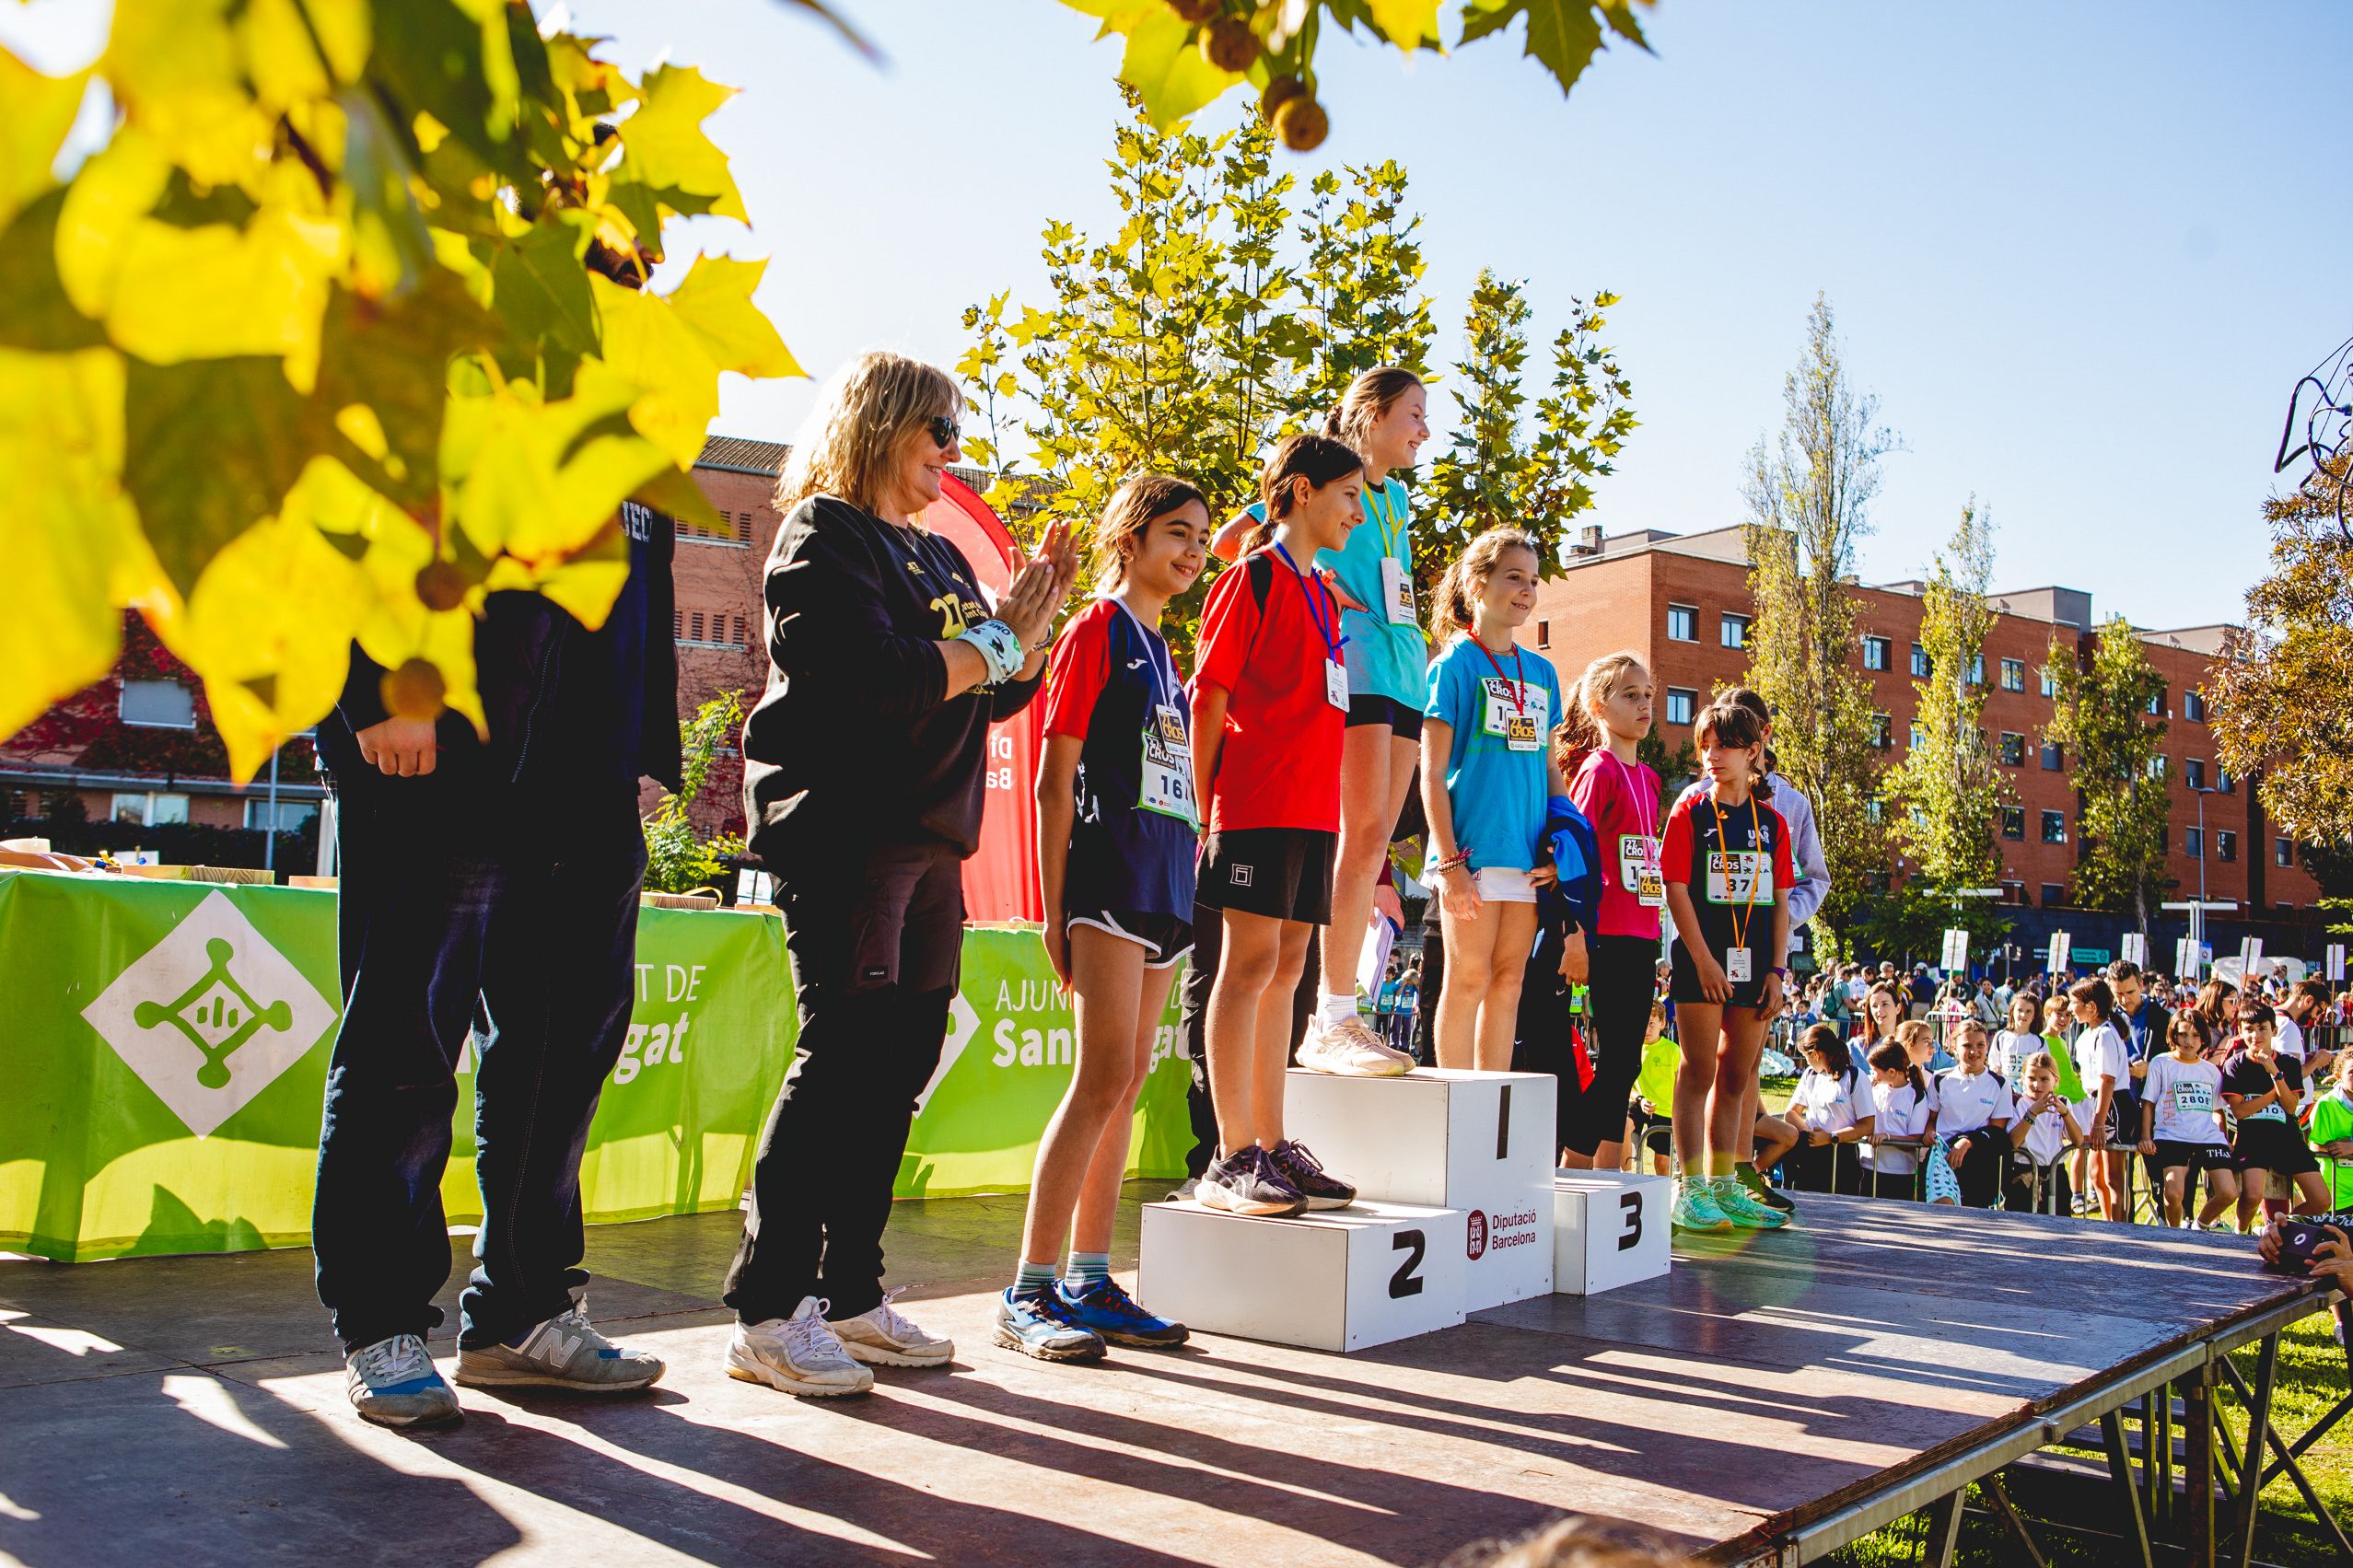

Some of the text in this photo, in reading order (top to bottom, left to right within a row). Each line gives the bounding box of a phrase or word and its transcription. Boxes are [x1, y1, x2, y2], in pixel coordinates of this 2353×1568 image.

[930, 593, 967, 640] 27
[1162, 723, 1184, 741] CROS
[1510, 726, 1535, 738] CROS
[1148, 746, 1174, 764] CROS
[1625, 847, 1645, 856] CRO
[1641, 883, 1660, 894] CROS
[666, 965, 706, 1003] DE
[992, 1018, 1077, 1068] San
[1492, 1208, 1537, 1233] Diputació
[1618, 1191, 1643, 1252] 3
[1491, 1229, 1537, 1251] Barcelona
[1388, 1228, 1426, 1300] 2
